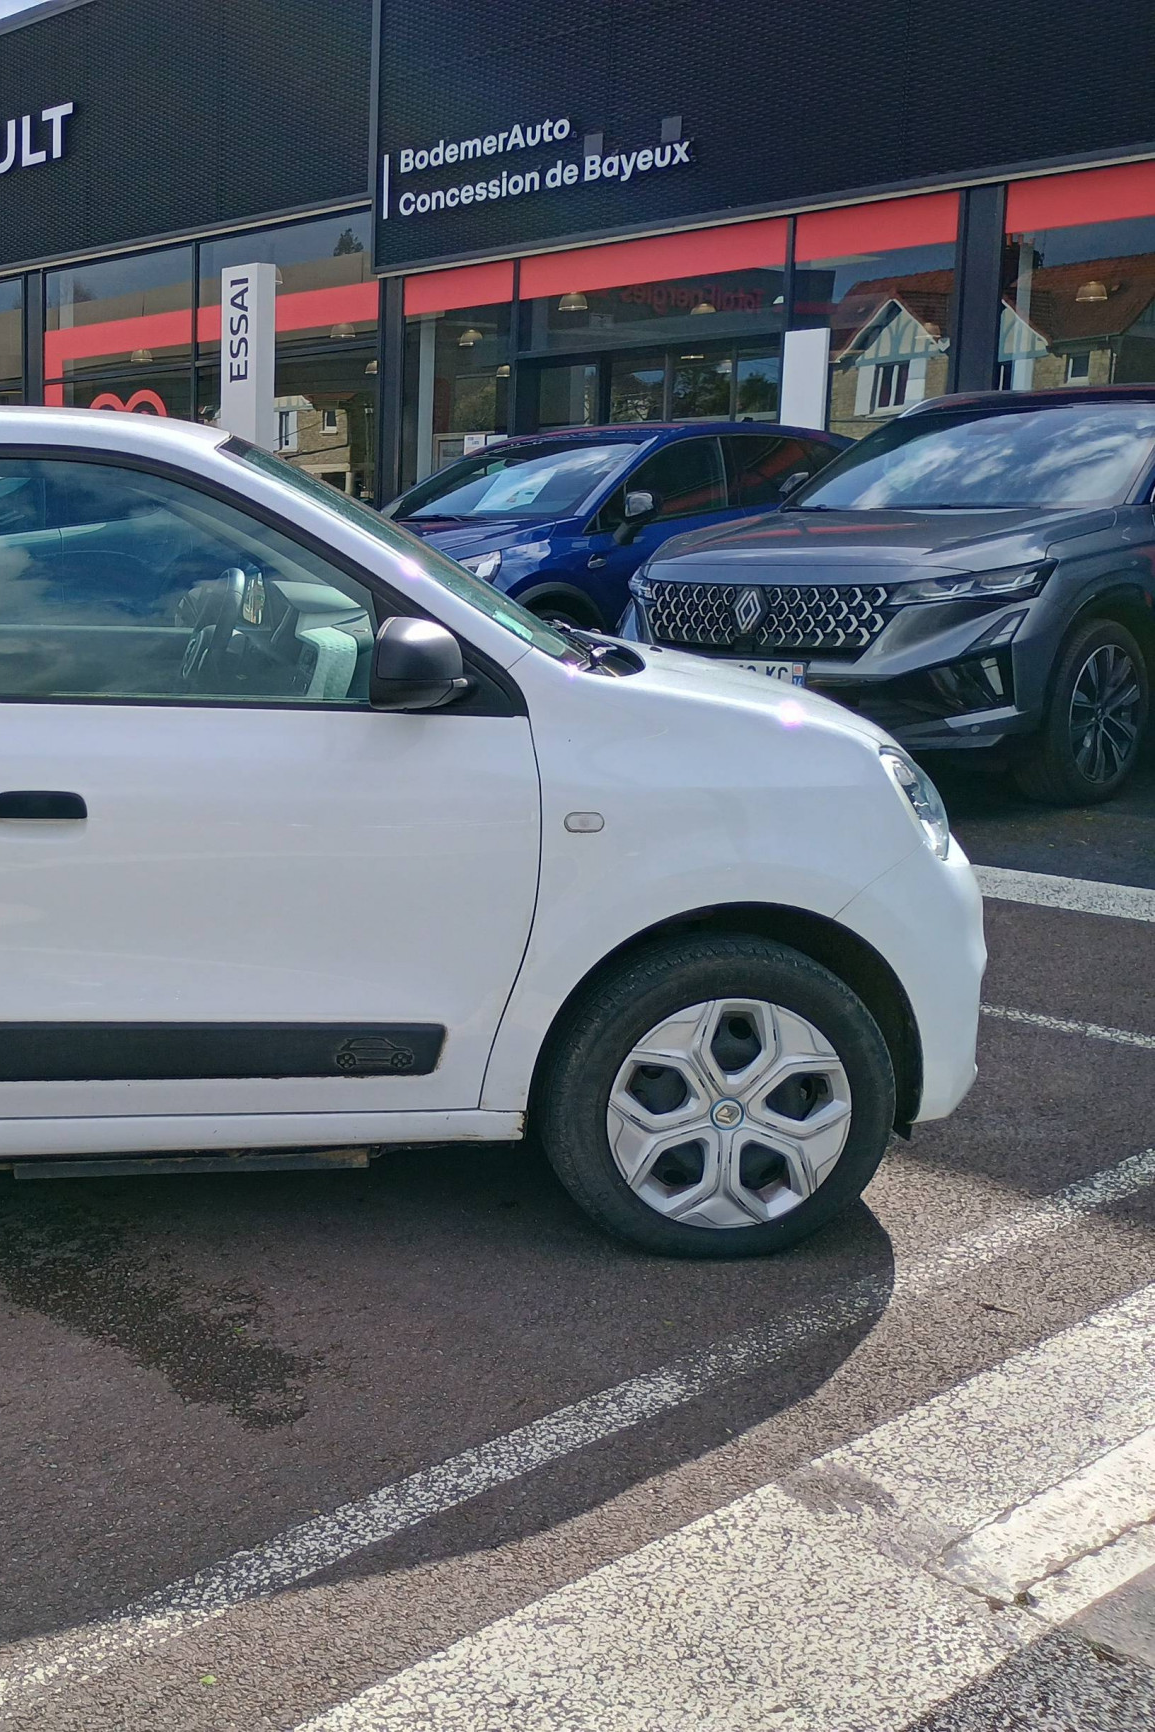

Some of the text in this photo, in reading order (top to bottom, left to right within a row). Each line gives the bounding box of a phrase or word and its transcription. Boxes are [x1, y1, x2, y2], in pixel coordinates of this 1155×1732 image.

[398, 141, 690, 216] Concession de Bayeux
[399, 117, 571, 173] BodemerAuto
[229, 277, 249, 383] ESSAI
